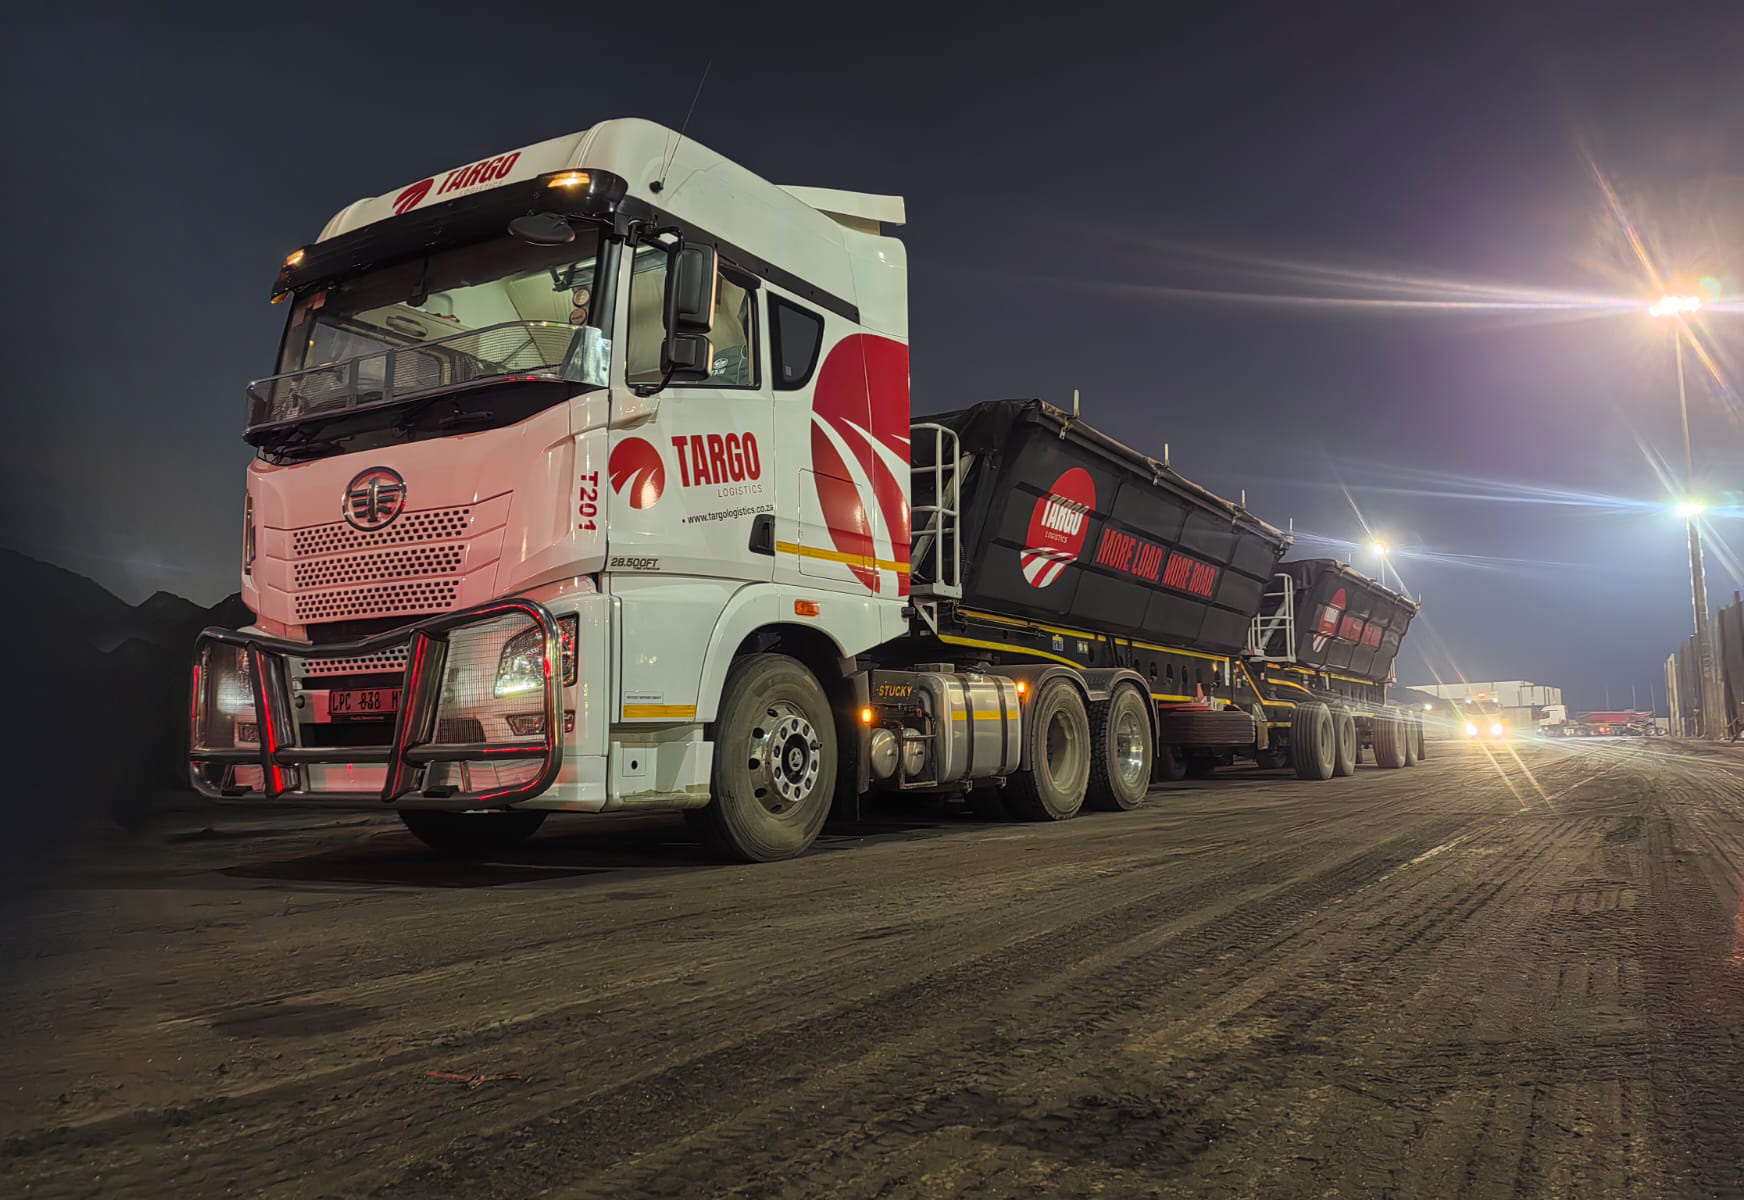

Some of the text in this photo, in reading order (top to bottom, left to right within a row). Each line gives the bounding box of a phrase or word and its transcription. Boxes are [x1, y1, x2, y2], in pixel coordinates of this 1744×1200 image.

[436, 151, 521, 195] TARGO
[671, 432, 760, 487] TARGO
[578, 471, 598, 531] T201
[717, 484, 763, 498] LOGISTICS
[687, 504, 774, 524] www.targologistics.co.za
[1041, 494, 1089, 536] TARGO
[610, 557, 659, 567] 28.500FT
[1096, 528, 1164, 582] MORE LOAD.
[1162, 552, 1193, 590] MORE
[878, 685, 913, 697] STUCKY
